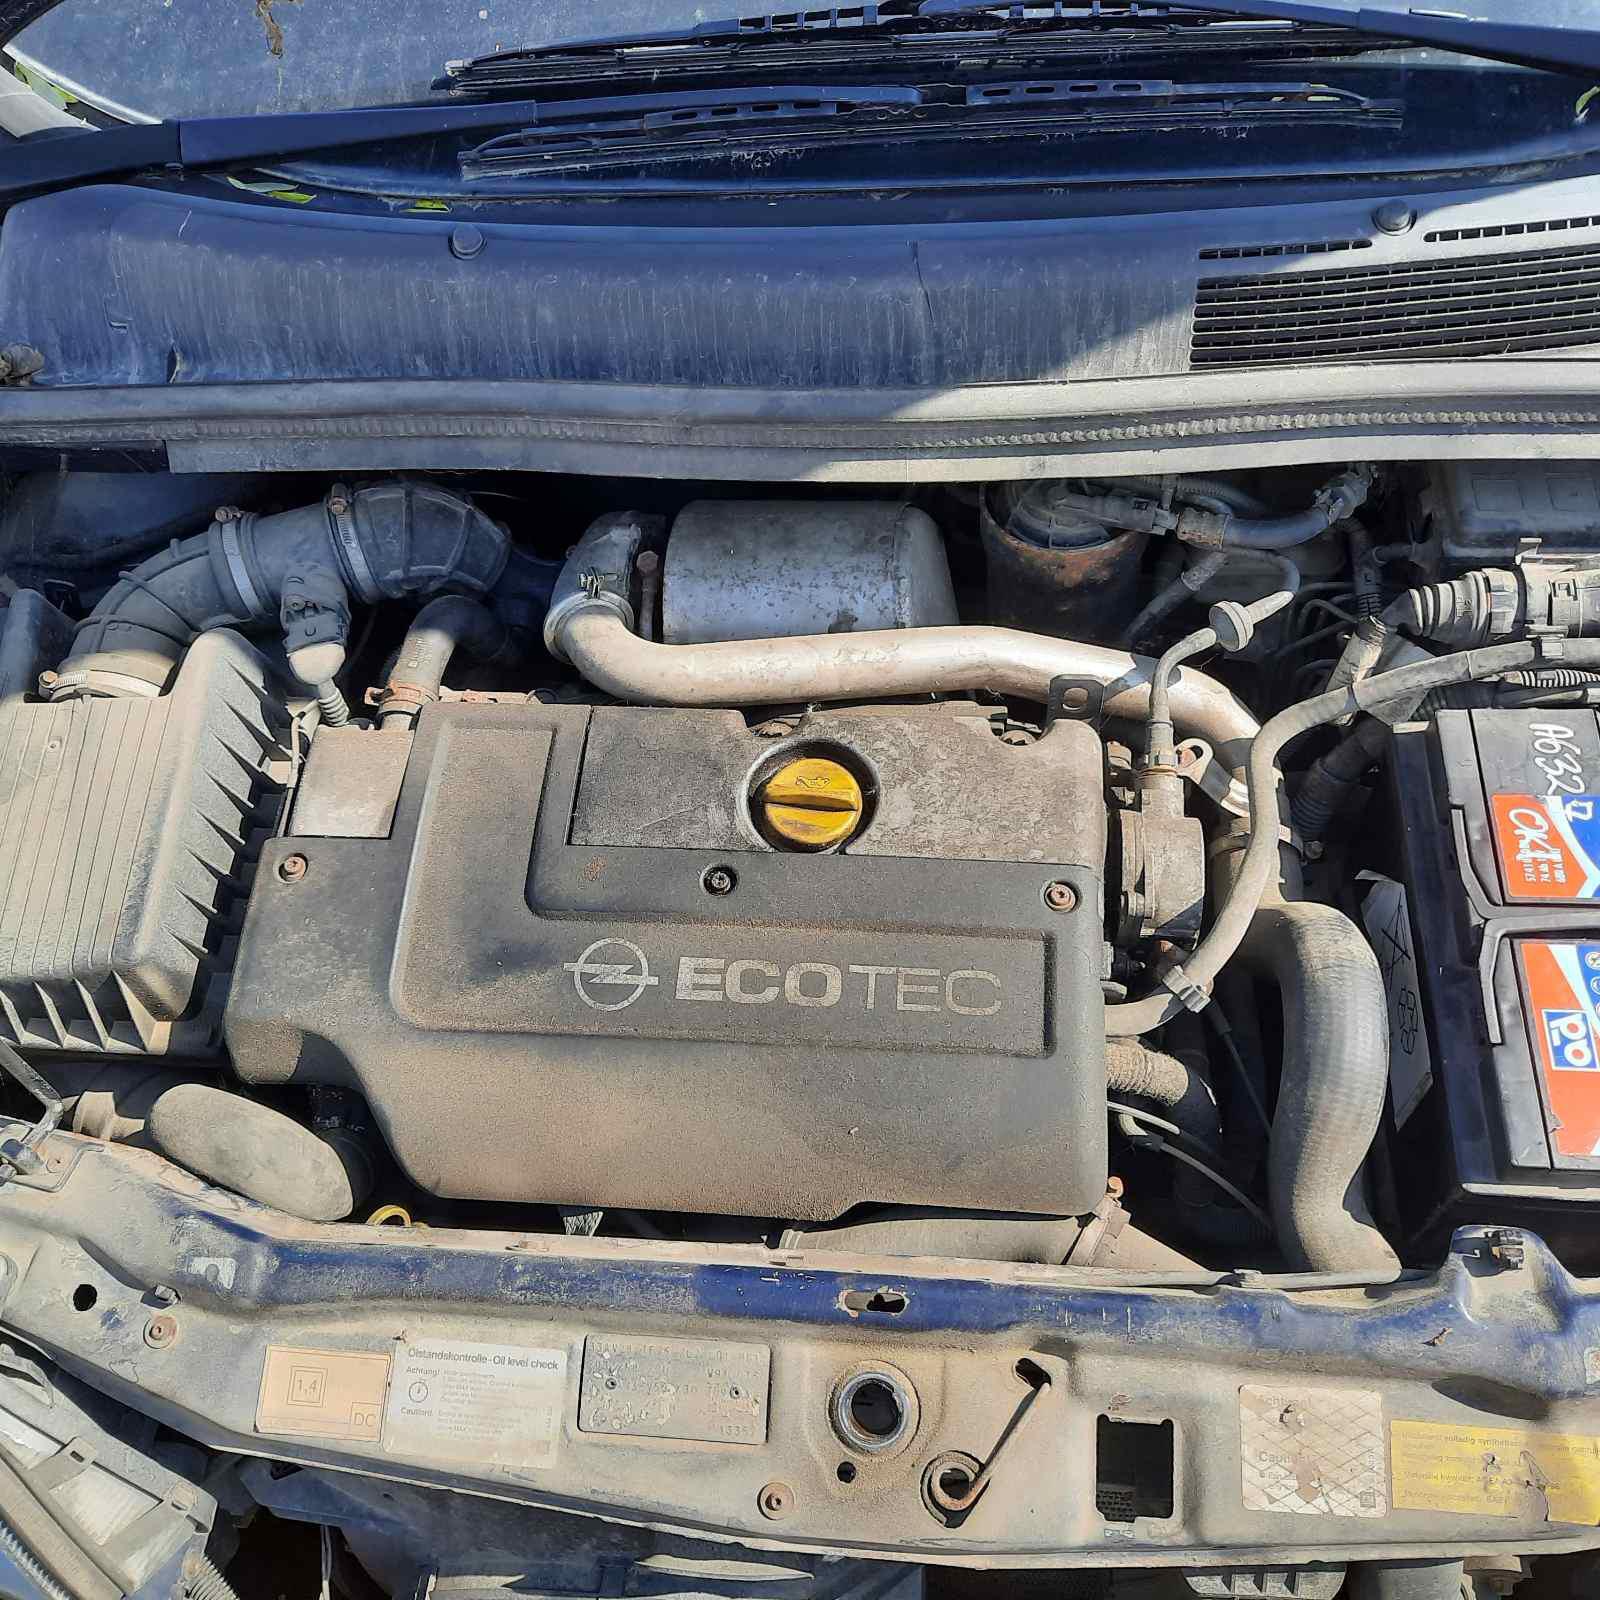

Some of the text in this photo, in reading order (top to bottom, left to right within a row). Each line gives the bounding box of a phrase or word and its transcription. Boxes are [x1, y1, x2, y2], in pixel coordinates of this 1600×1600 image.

[675, 956, 1001, 1016] ECOTEC
[507, 1357, 528, 1368] level
[530, 1358, 559, 1370] check
[353, 1411, 376, 1427] DC
